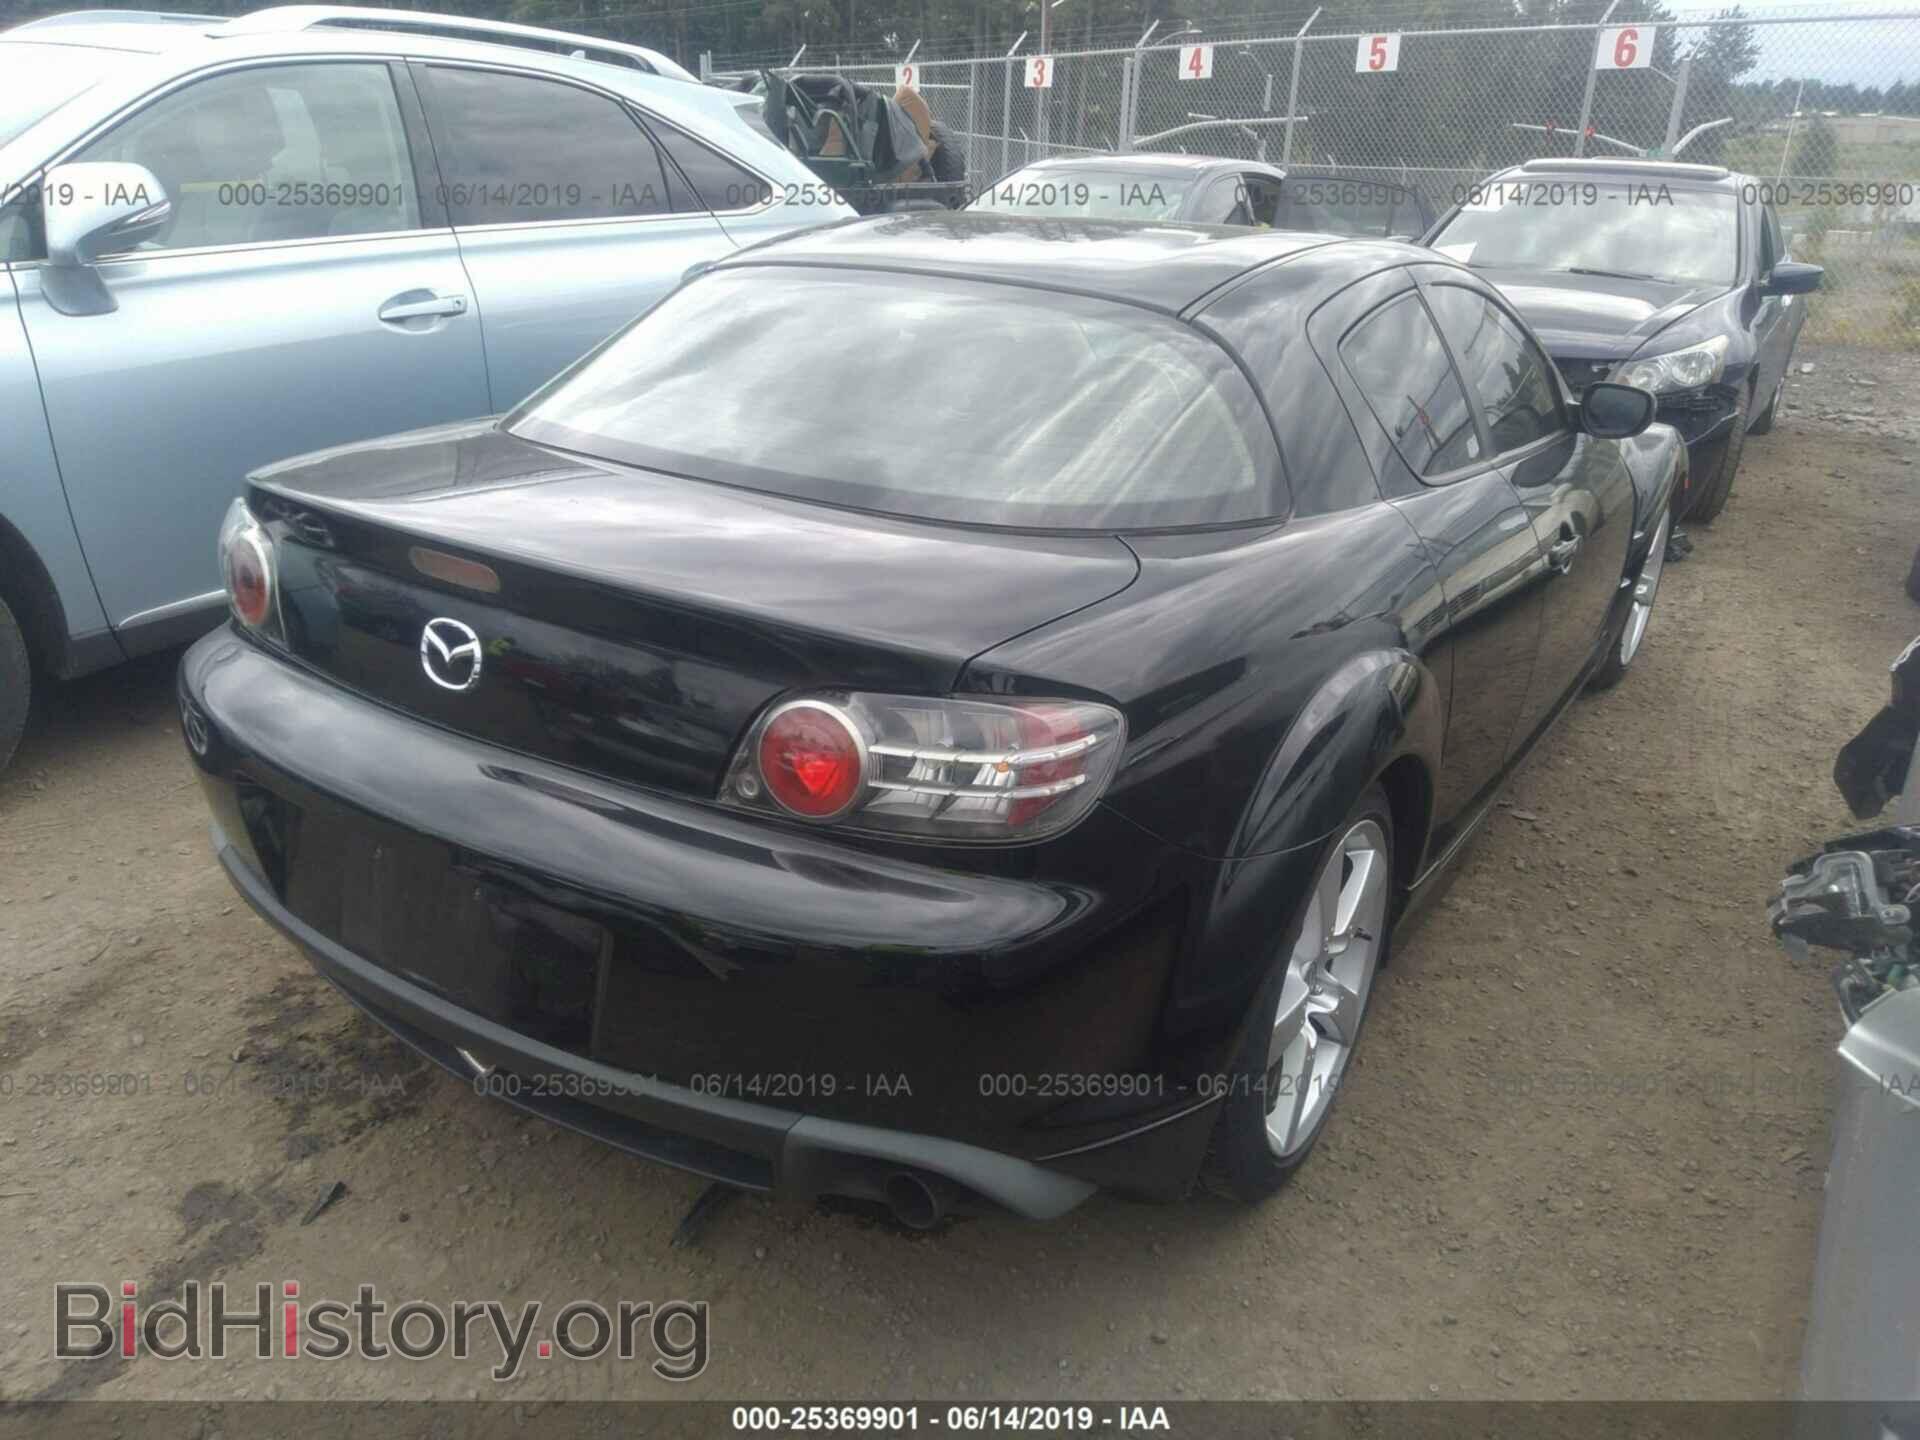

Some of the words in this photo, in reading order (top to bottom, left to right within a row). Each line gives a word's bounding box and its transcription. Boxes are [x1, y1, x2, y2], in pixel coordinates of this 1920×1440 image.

[1188, 47, 1204, 78] 4
[1368, 37, 1388, 70] 5
[1613, 28, 1639, 68] 6
[1032, 59, 1046, 86] 3
